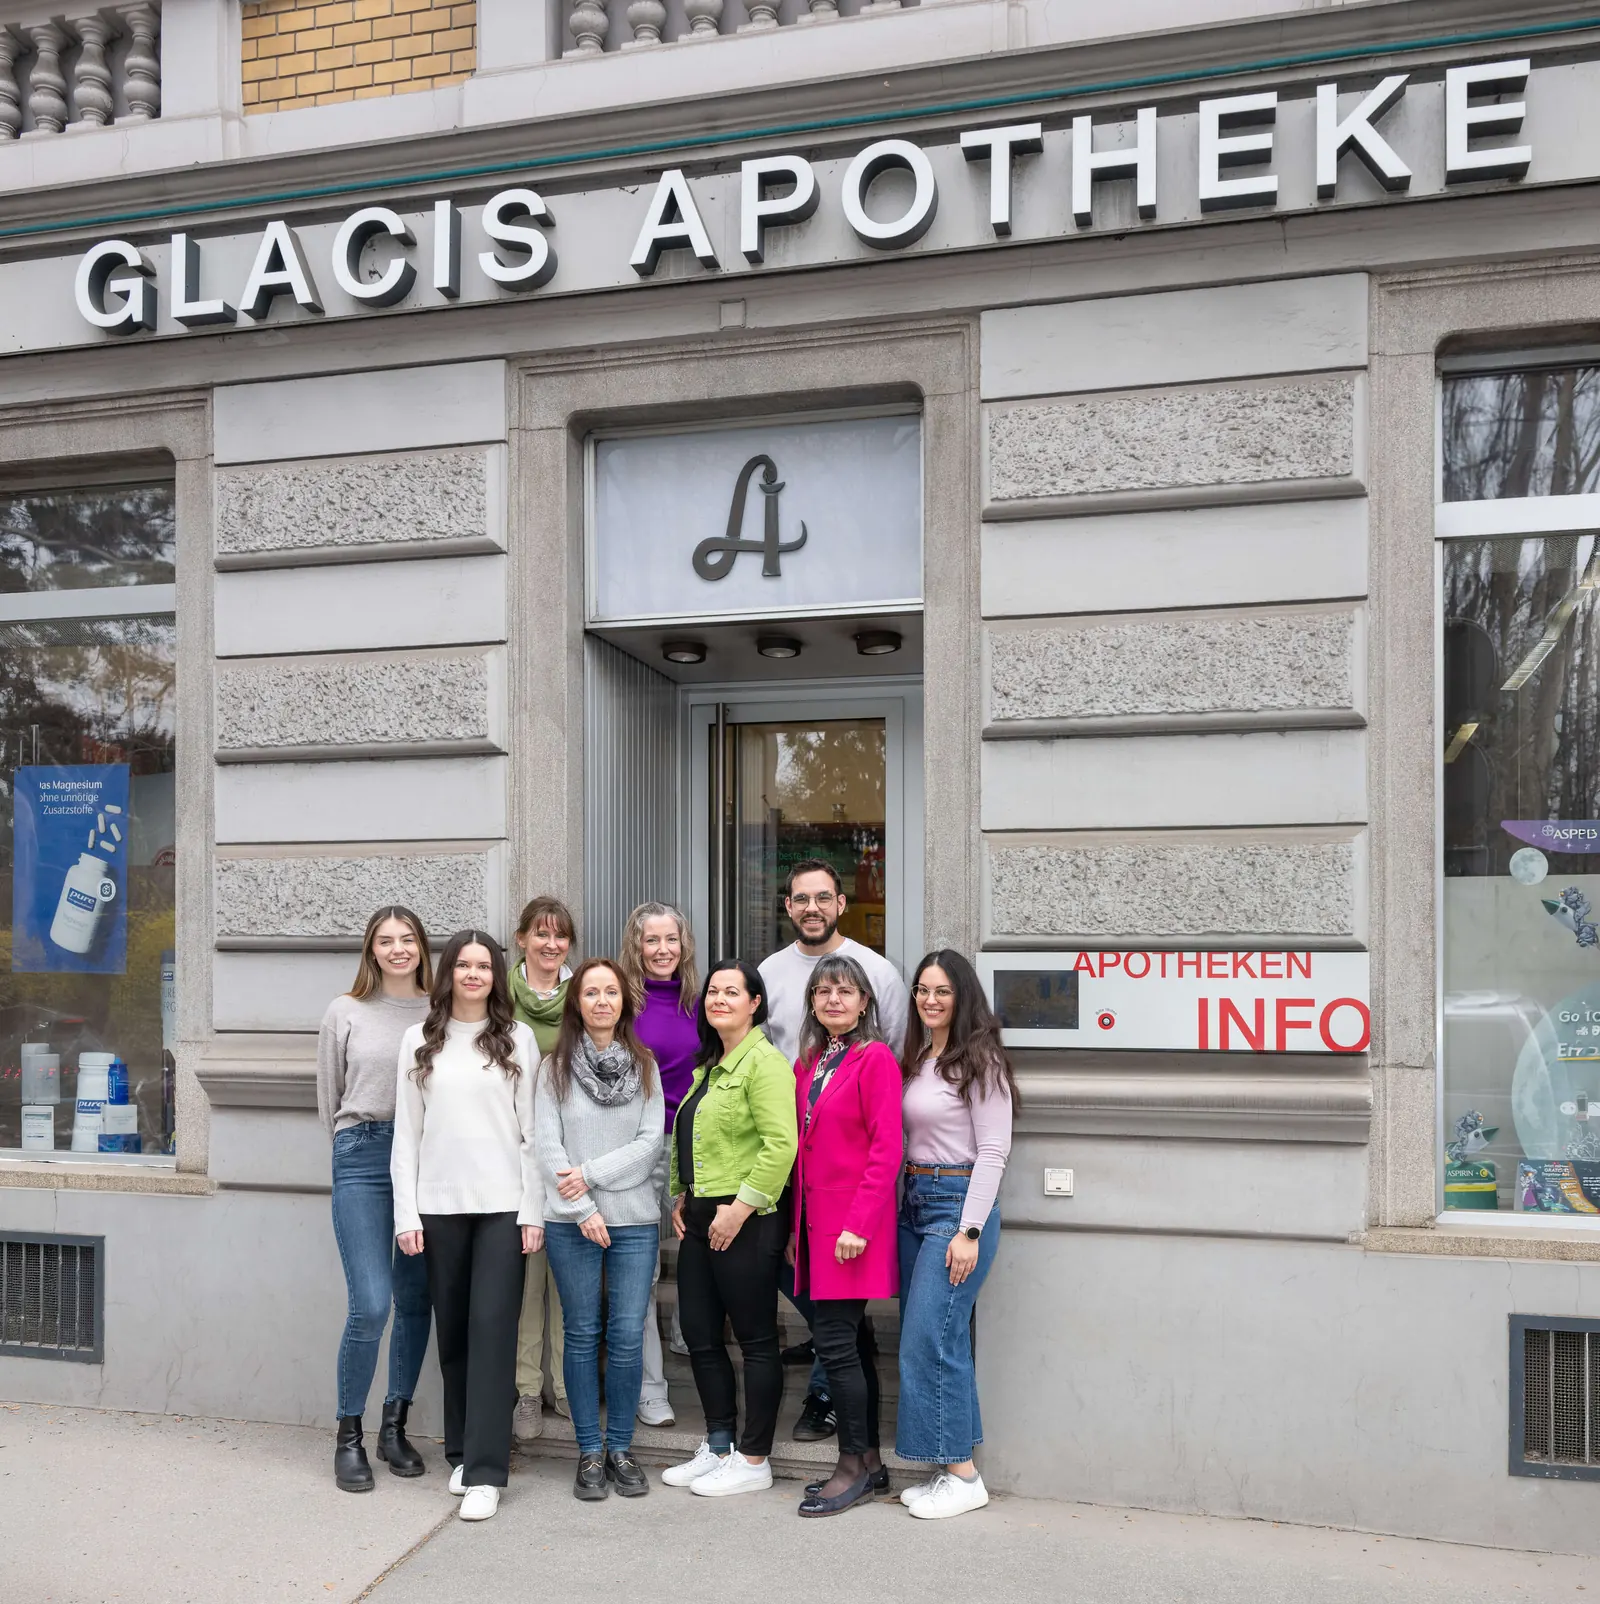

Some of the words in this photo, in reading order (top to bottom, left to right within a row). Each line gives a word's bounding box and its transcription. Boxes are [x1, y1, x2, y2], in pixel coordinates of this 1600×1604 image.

[75, 188, 557, 335] GLACIS
[630, 59, 1533, 275] APOTHEKE
[52, 780, 103, 792] Magnesium
[61, 792, 99, 805] unnötige
[43, 804, 94, 815] Zusatzstoffe
[69, 890, 96, 905] pure
[1073, 952, 1313, 979] APOTHEKEN
[1198, 997, 1371, 1053] INFO
[1446, 1169, 1474, 1177] ASPIRIN
